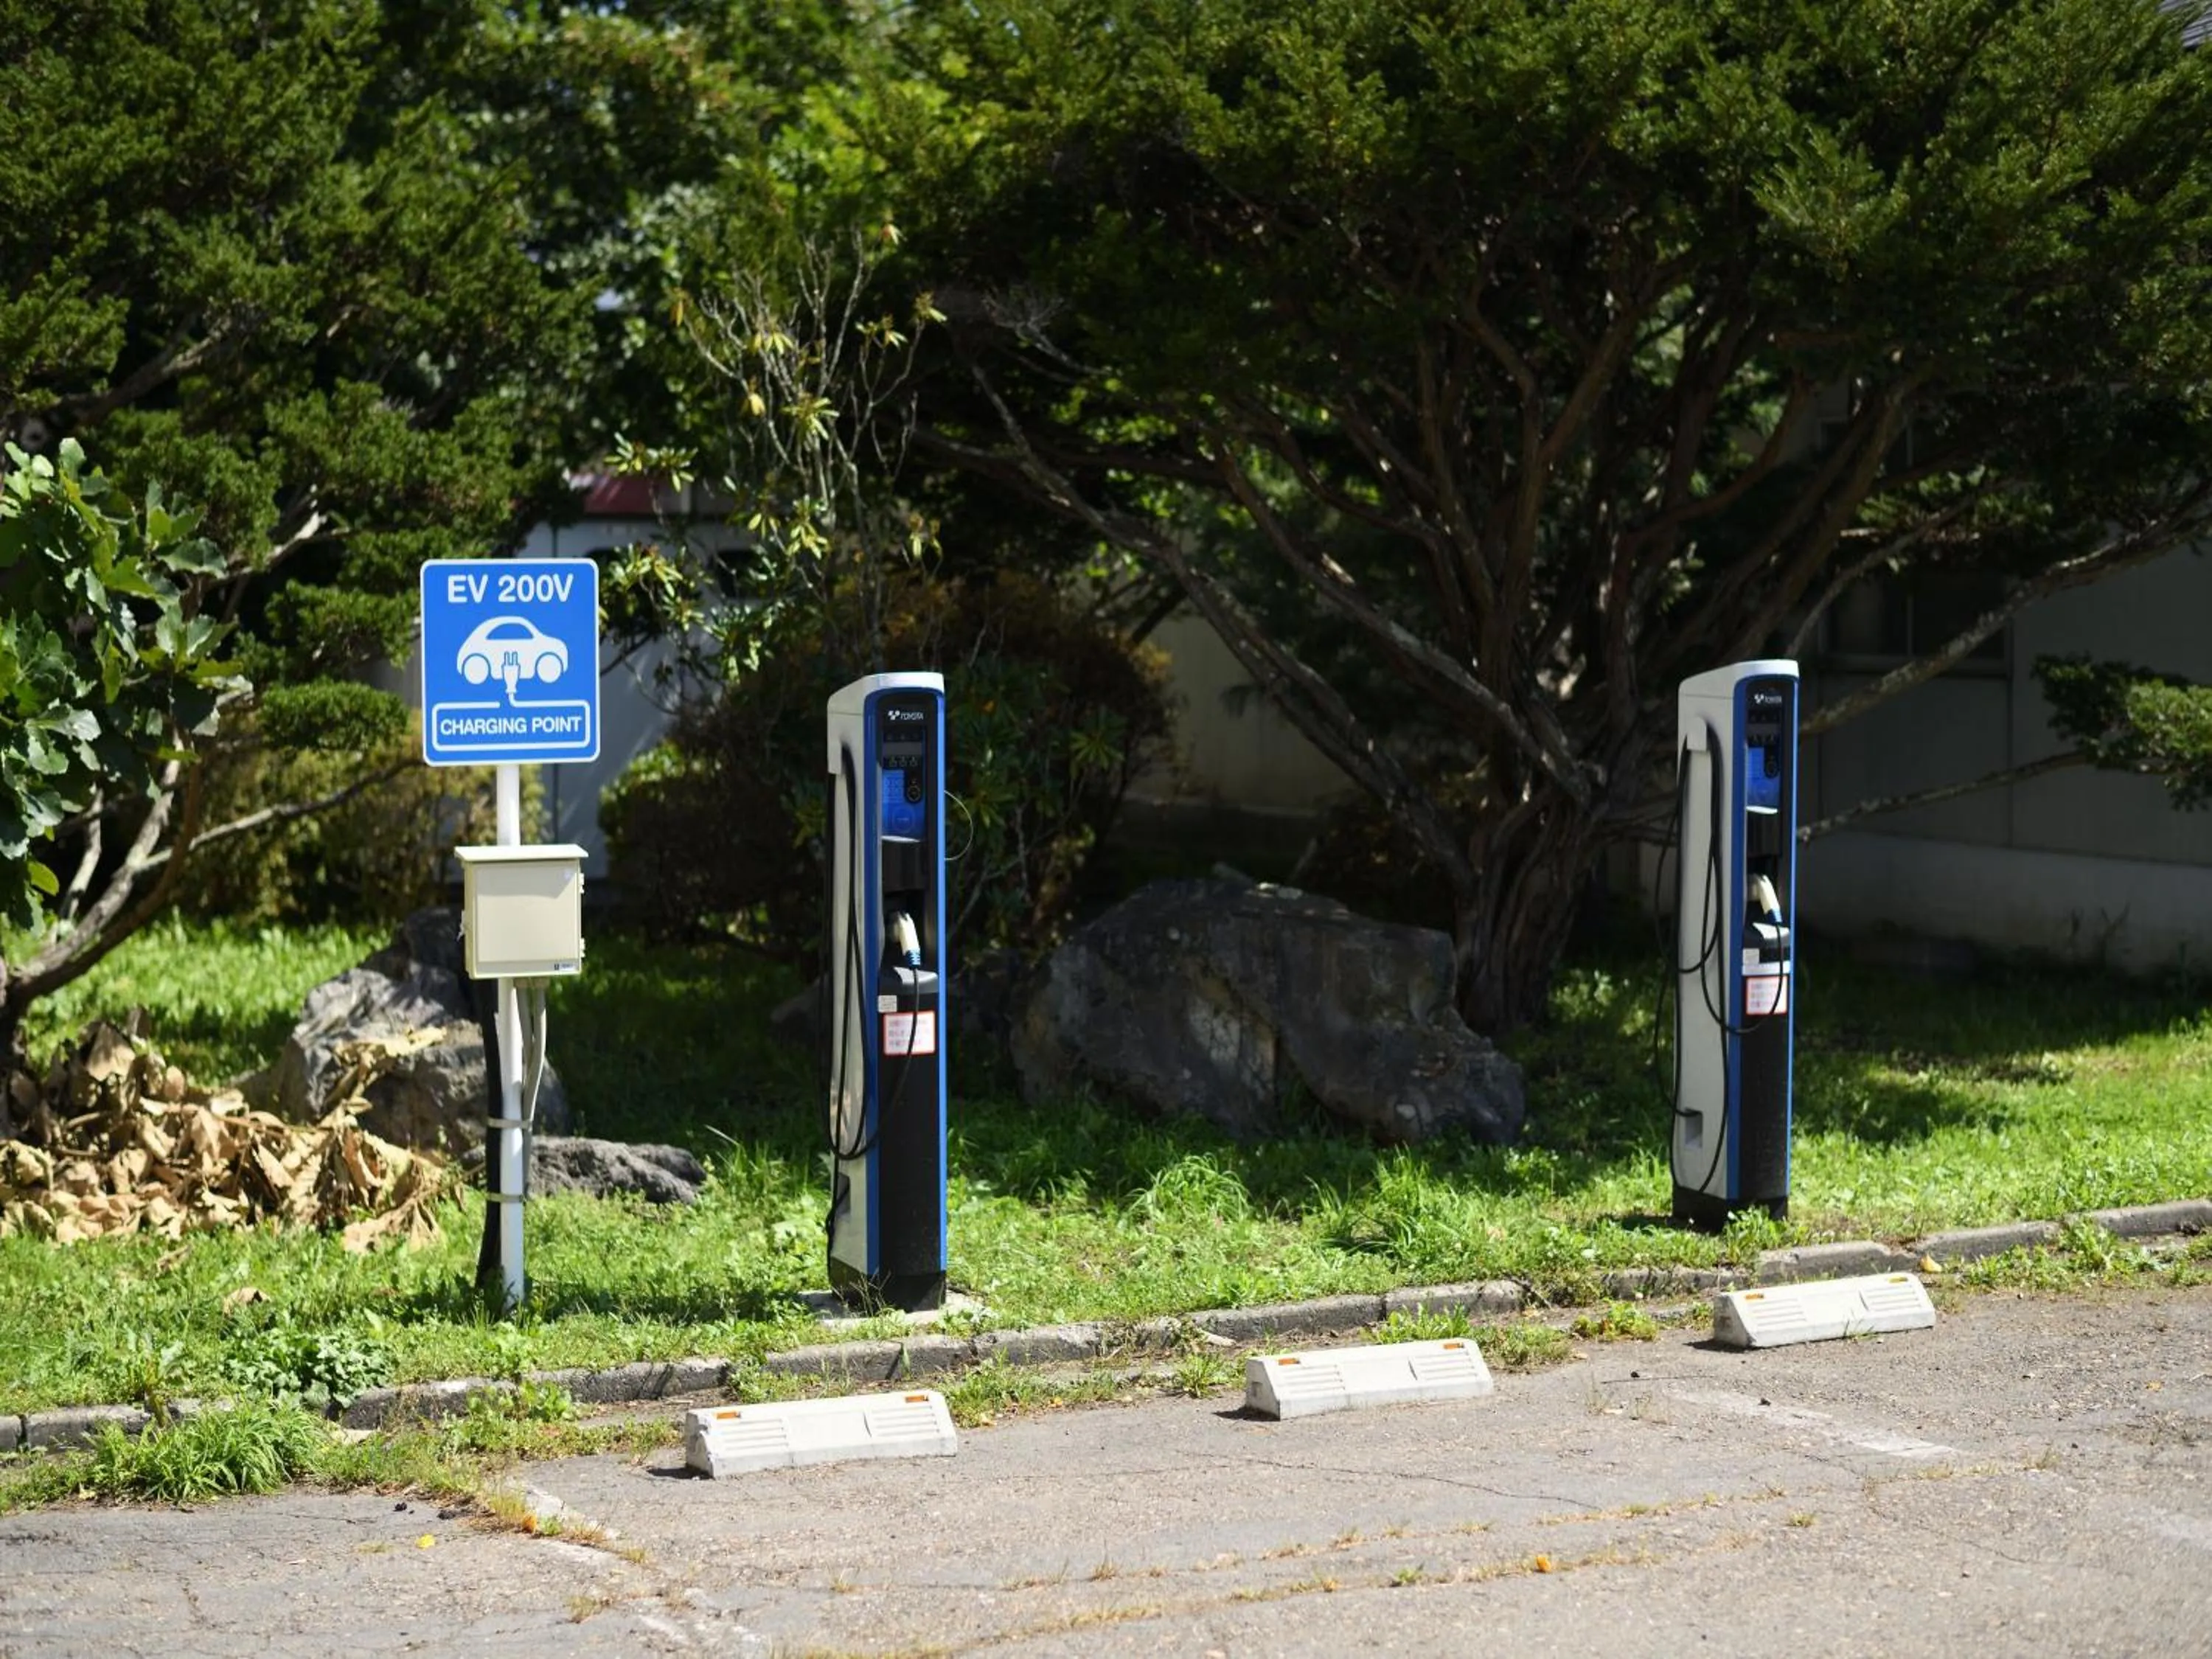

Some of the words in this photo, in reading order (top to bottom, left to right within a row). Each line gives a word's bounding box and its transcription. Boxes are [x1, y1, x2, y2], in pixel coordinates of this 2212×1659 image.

[448, 574, 488, 603] EV
[498, 574, 573, 602] 200V
[440, 719, 526, 735] CHARGING
[532, 716, 582, 733] POINT
